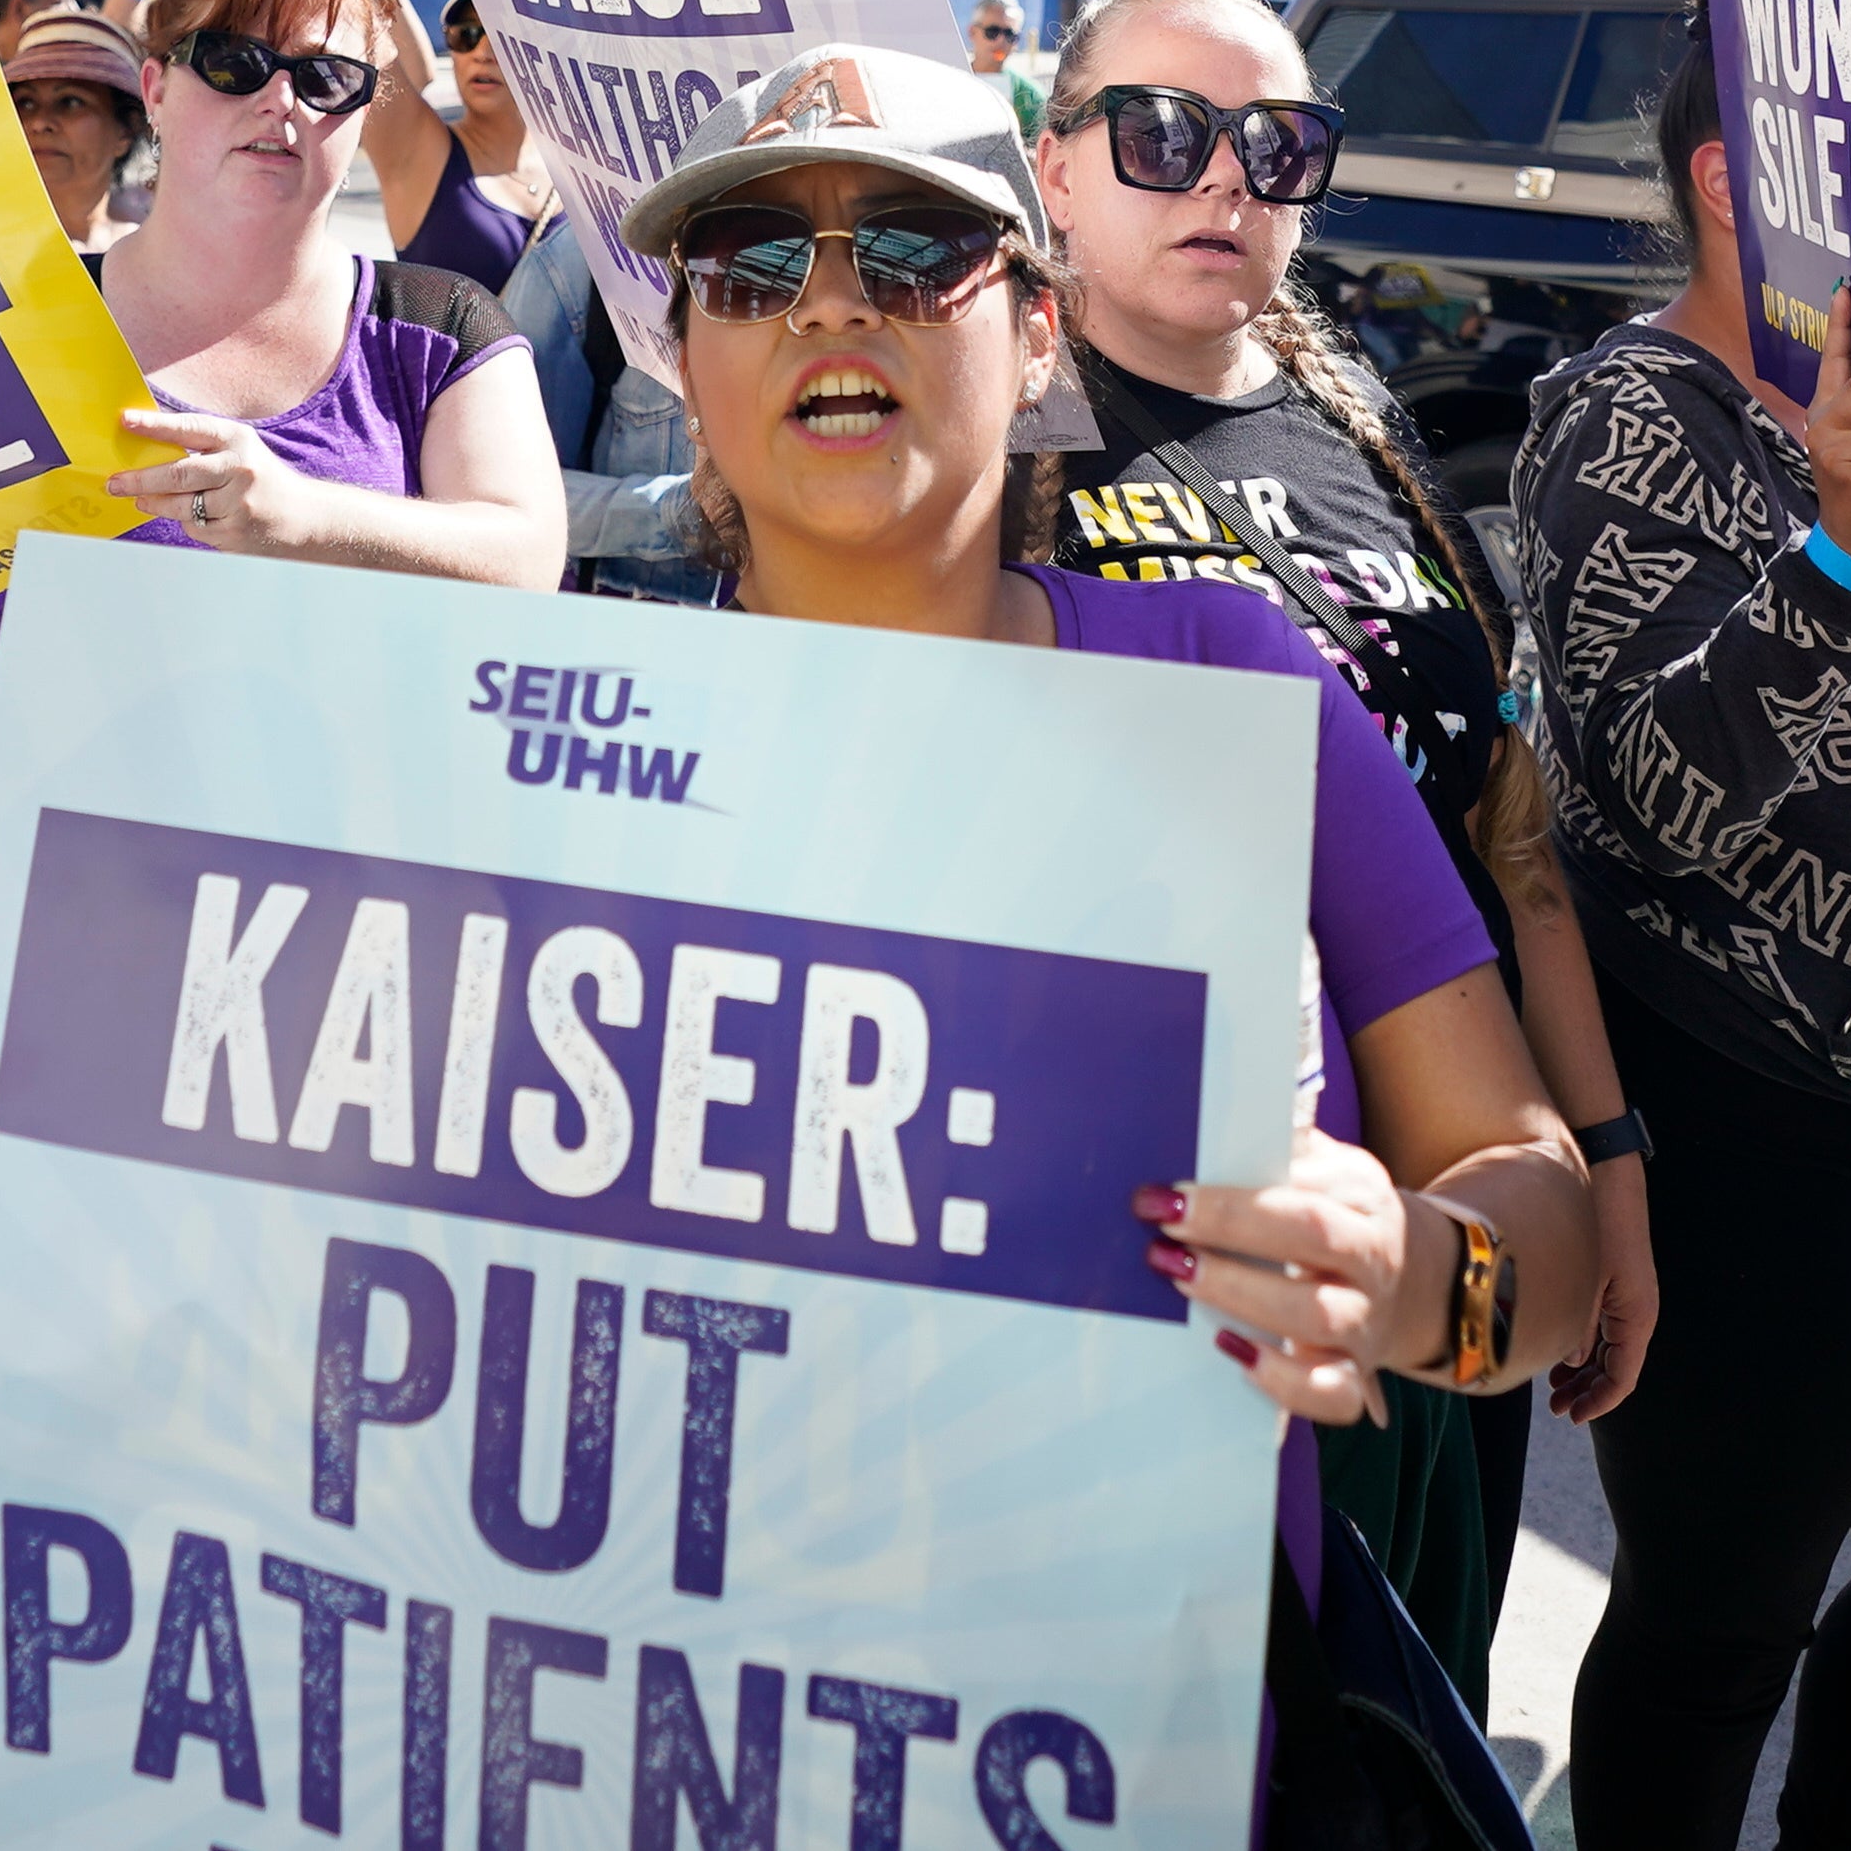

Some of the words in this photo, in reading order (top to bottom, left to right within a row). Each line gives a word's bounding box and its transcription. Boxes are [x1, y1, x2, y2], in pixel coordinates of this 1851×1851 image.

[496, 29, 761, 184] HEALTHC
[1761, 282, 1787, 333] ULP
[468, 659, 653, 730] SEIU-
[505, 728, 702, 806] UHW
[162, 872, 995, 1257] KAISER:
[308, 1235, 792, 1600] PUT
[0, 1500, 1120, 1851] PATIENTS
